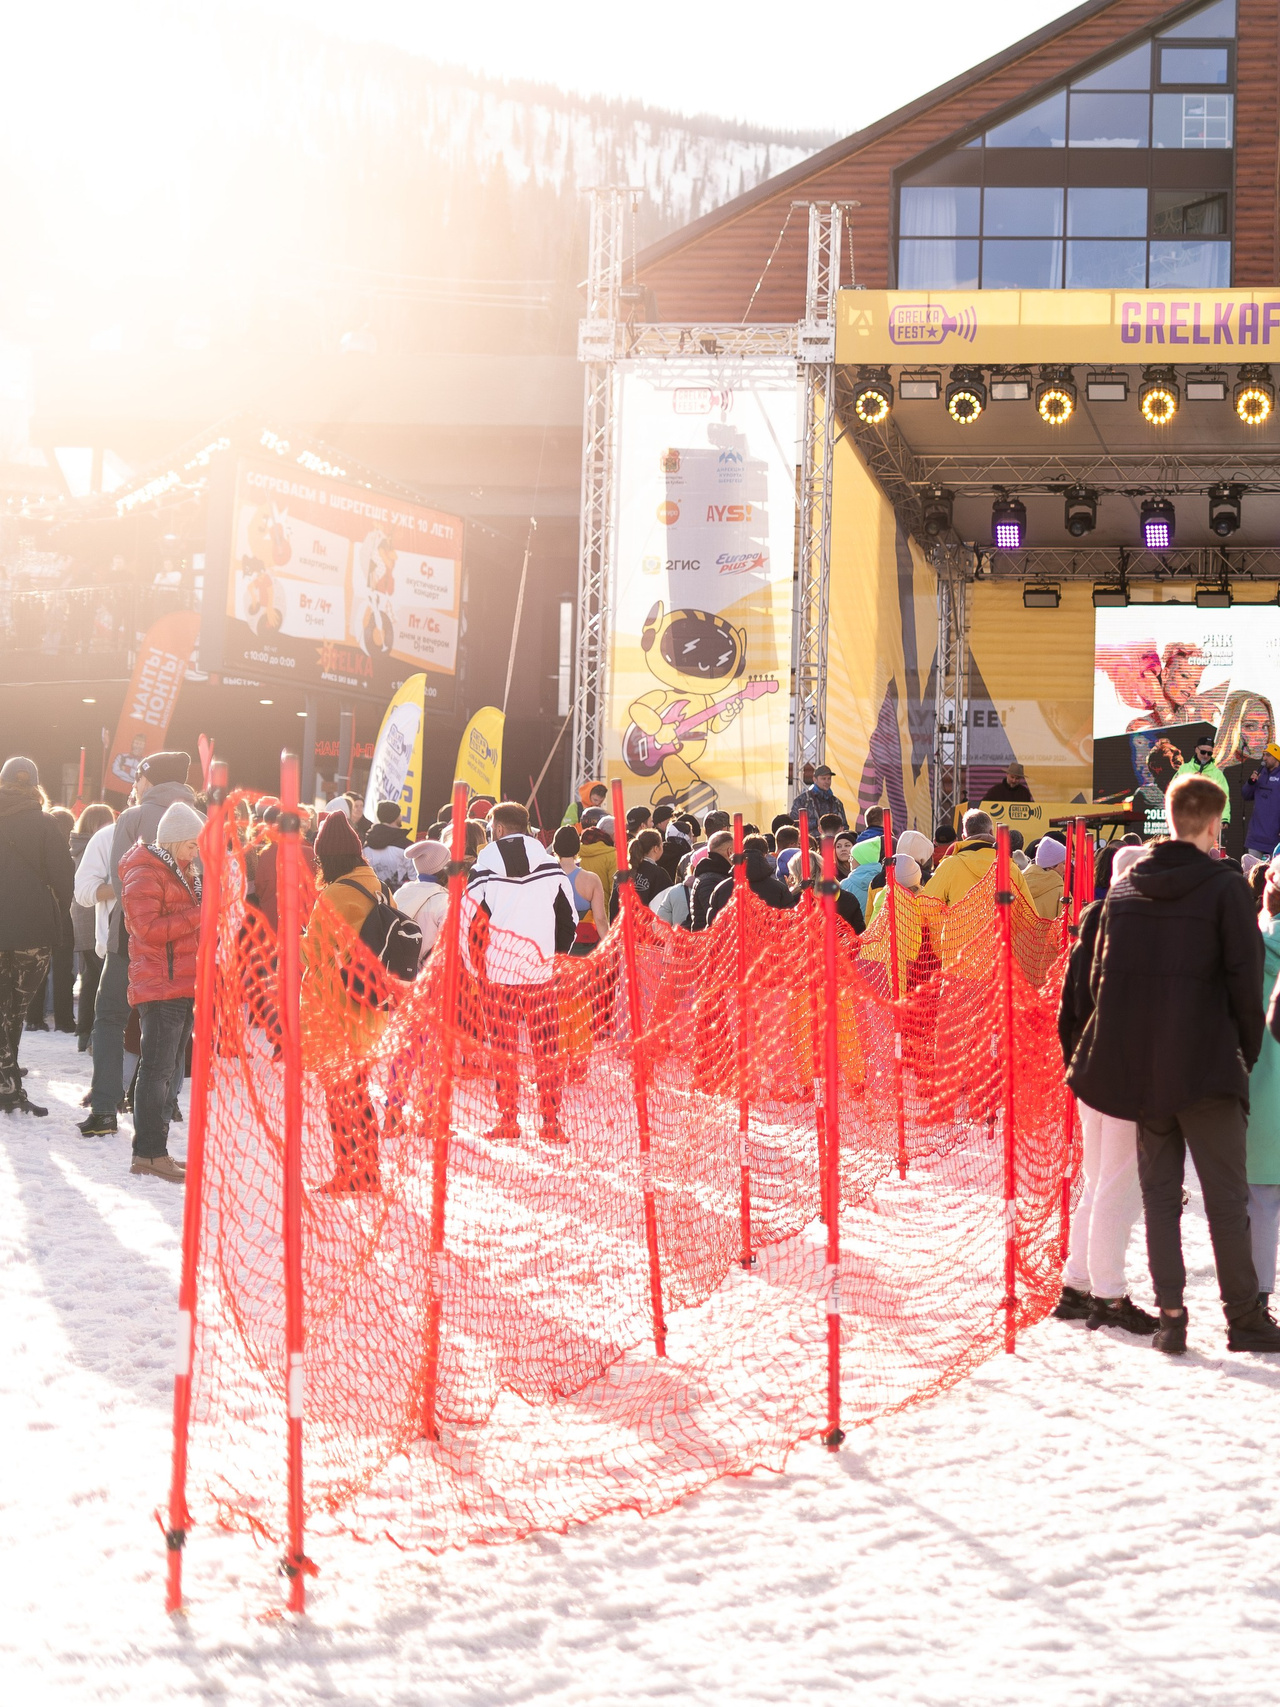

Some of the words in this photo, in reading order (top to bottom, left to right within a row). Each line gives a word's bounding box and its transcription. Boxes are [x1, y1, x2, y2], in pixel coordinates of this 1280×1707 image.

[898, 310, 940, 324] GRELKA
[898, 326, 926, 339] FEST
[246, 471, 316, 501] СОГРЕВАЕМ
[319, 490, 327, 504] В
[329, 493, 388, 522] ШЕРЕГЕШЕ
[390, 510, 415, 529] УЖЕ
[418, 518, 429, 533] 10
[430, 522, 454, 539] ЛЕТ!
[706, 505, 752, 522] AYS!
[666, 560, 701, 571] 2ГИС
[250, 650, 269, 663] 10:00
[130, 647, 164, 720] МАНТЫ
[144, 651, 178, 726] ПОНТЫ
